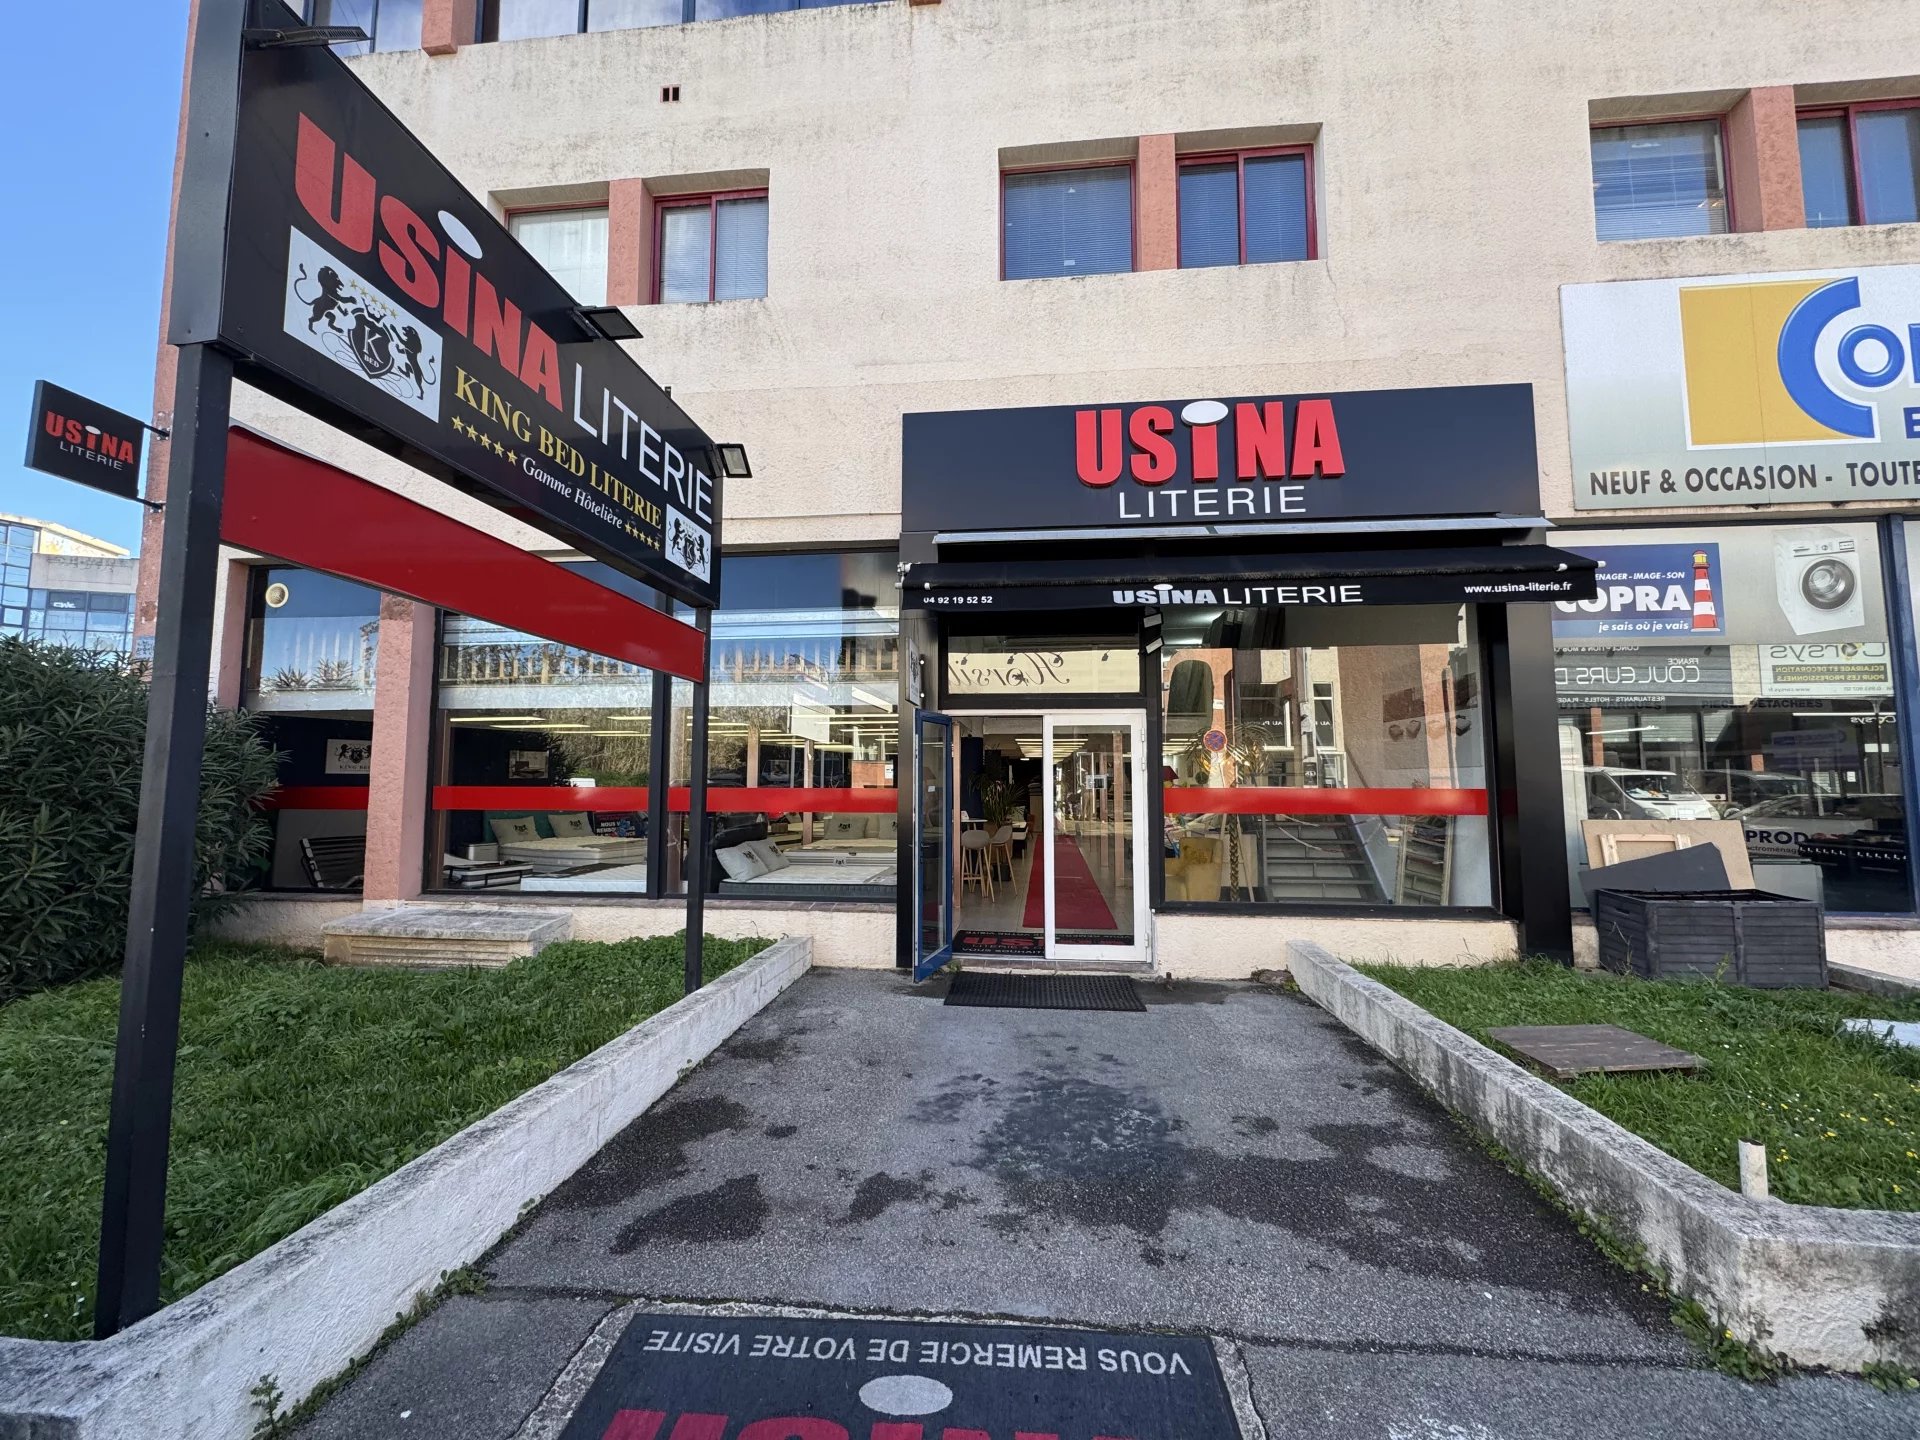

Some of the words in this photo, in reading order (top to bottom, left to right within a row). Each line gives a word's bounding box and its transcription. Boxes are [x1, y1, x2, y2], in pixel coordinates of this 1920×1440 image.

[295, 112, 564, 412] USINA
[45, 410, 134, 464] USINA
[455, 366, 532, 443] KING
[538, 425, 585, 477] BED
[590, 462, 662, 530] LITERIE
[573, 362, 713, 525] LITERIE
[1075, 399, 1346, 486] USINA
[59, 441, 123, 471] LITERIE
[522, 457, 572, 498] Gamme
[574, 487, 623, 529] Hôtelière
[1590, 470, 1650, 496] NEUF
[1659, 469, 1677, 493] &
[1685, 464, 1817, 493] OCCASION
[1119, 485, 1306, 518] LITERIE
[1464, 582, 1572, 594] www.usina-literie.fr
[1633, 572, 1661, 580] IMAGE
[1666, 571, 1685, 579] SON
[923, 596, 935, 604] 04
[937, 596, 950, 604] 92
[952, 596, 964, 604] 19
[966, 596, 978, 604] 52
[981, 596, 993, 604] 52
[1113, 584, 1217, 605] USINA
[1223, 585, 1363, 605] LITERIE
[1598, 621, 1609, 633] je
[1611, 621, 1633, 631] sais
[1636, 621, 1650, 631] où
[1652, 621, 1664, 632] je
[1665, 620, 1688, 630] vais
[643, 1330, 740, 1355] VISITE
[749, 1335, 856, 1360] VOTRE
[867, 1338, 910, 1362] DE
[919, 1341, 1087, 1370] REMERCIE
[1098, 1349, 1191, 1375] VOUS
